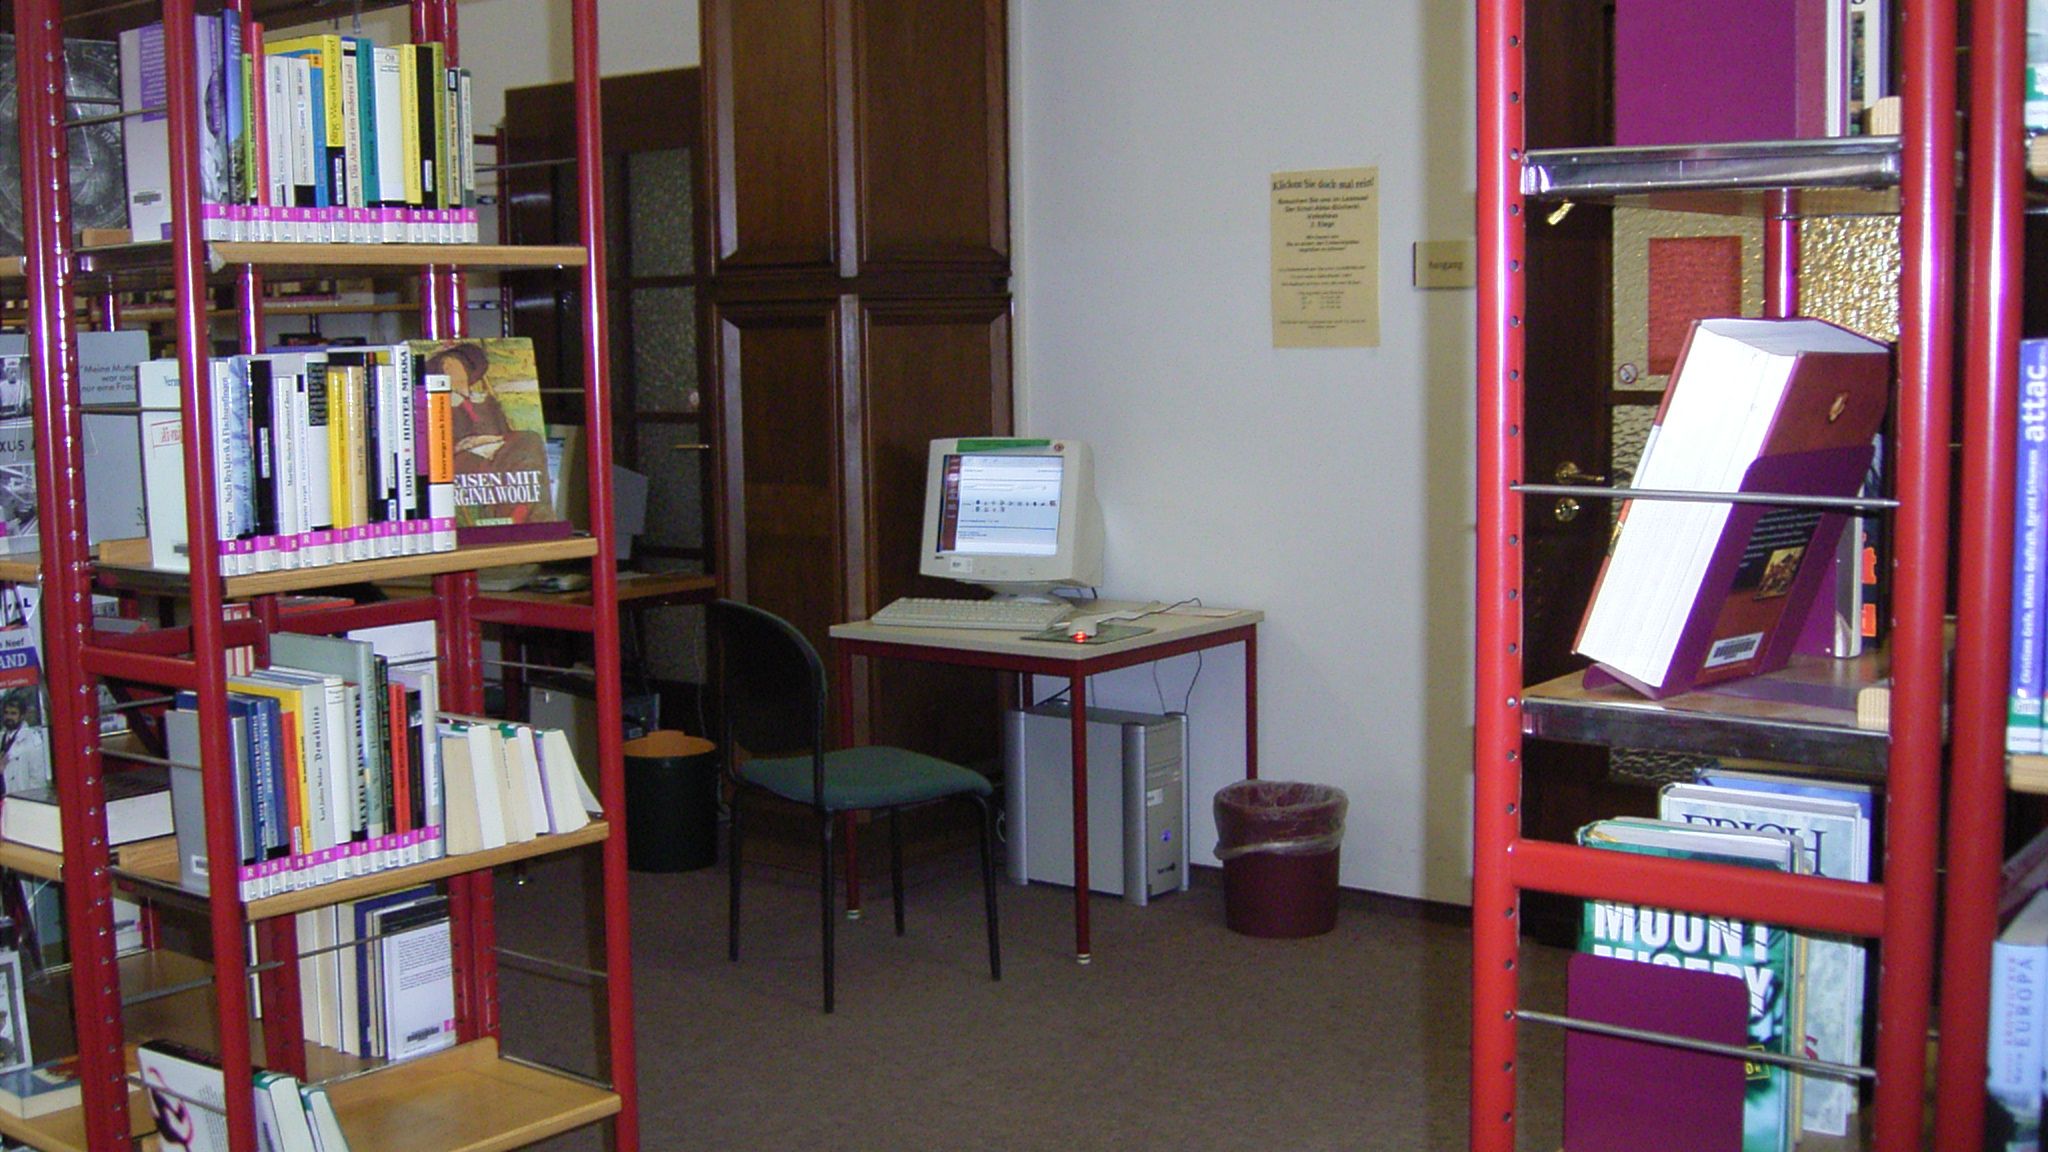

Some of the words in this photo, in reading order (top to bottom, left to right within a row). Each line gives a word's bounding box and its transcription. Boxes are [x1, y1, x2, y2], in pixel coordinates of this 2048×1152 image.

[345, 64, 354, 84] Land
[347, 85, 356, 117] anderes
[349, 131, 357, 141] ist
[349, 143, 358, 162] Alter
[350, 164, 359, 179] Das
[1304, 179, 1316, 189] Sie
[1317, 179, 1337, 189] doch
[1339, 179, 1355, 189] mal
[400, 350, 409, 392] MEKKA
[402, 396, 411, 441] HINTER
[2021, 364, 2047, 442] attac
[223, 446, 233, 483] Reykjavik
[403, 457, 413, 497] UDINK
[506, 470, 541, 486] MIT
[2026, 449, 2038, 494] Schumann
[224, 484, 232, 504] Nach
[495, 485, 541, 503] WOOLF
[2023, 574, 2034, 608] Mathias
[2021, 640, 2032, 683] Christiane
[354, 694, 362, 737] BILDER
[357, 743, 365, 776] REISE
[2015, 959, 2033, 1048] EUROPA
